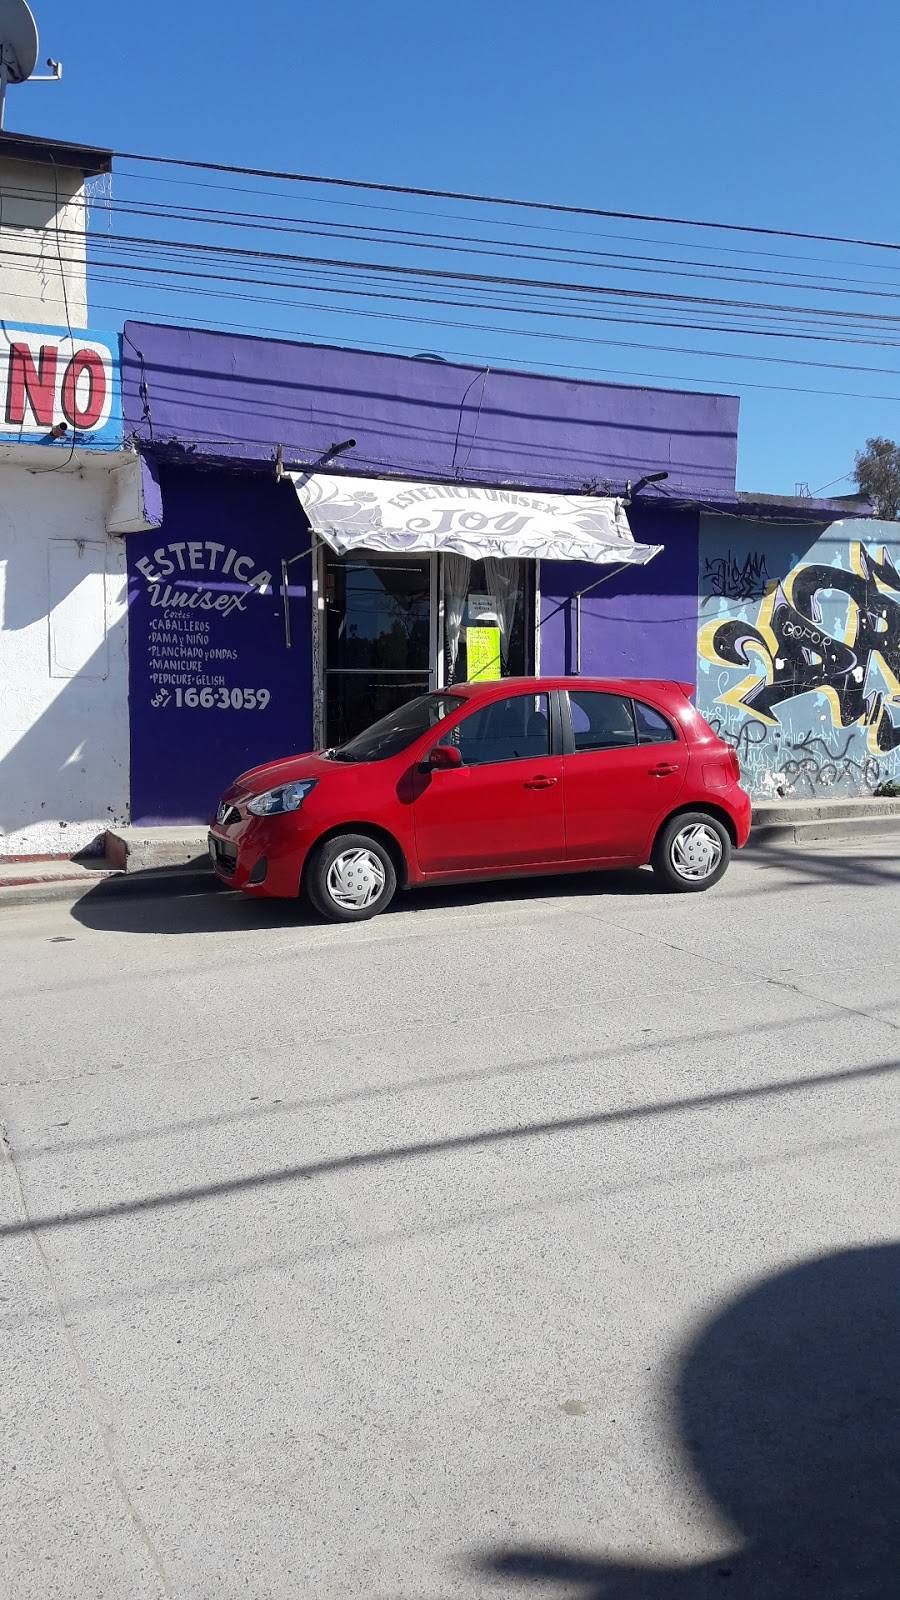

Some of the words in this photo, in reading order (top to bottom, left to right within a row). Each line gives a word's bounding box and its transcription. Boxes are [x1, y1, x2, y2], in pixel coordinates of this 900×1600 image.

[388, 485, 480, 510] ESTETICA
[483, 488, 560, 516] UNISEX
[135, 541, 272, 594] ESTETICA
[148, 583, 247, 617] Unisex
[186, 633, 209, 645] NIÑO
[151, 646, 203, 658] PLANCHADO
[209, 649, 238, 660] ONDAS
[152, 659, 203, 672] MANICURE
